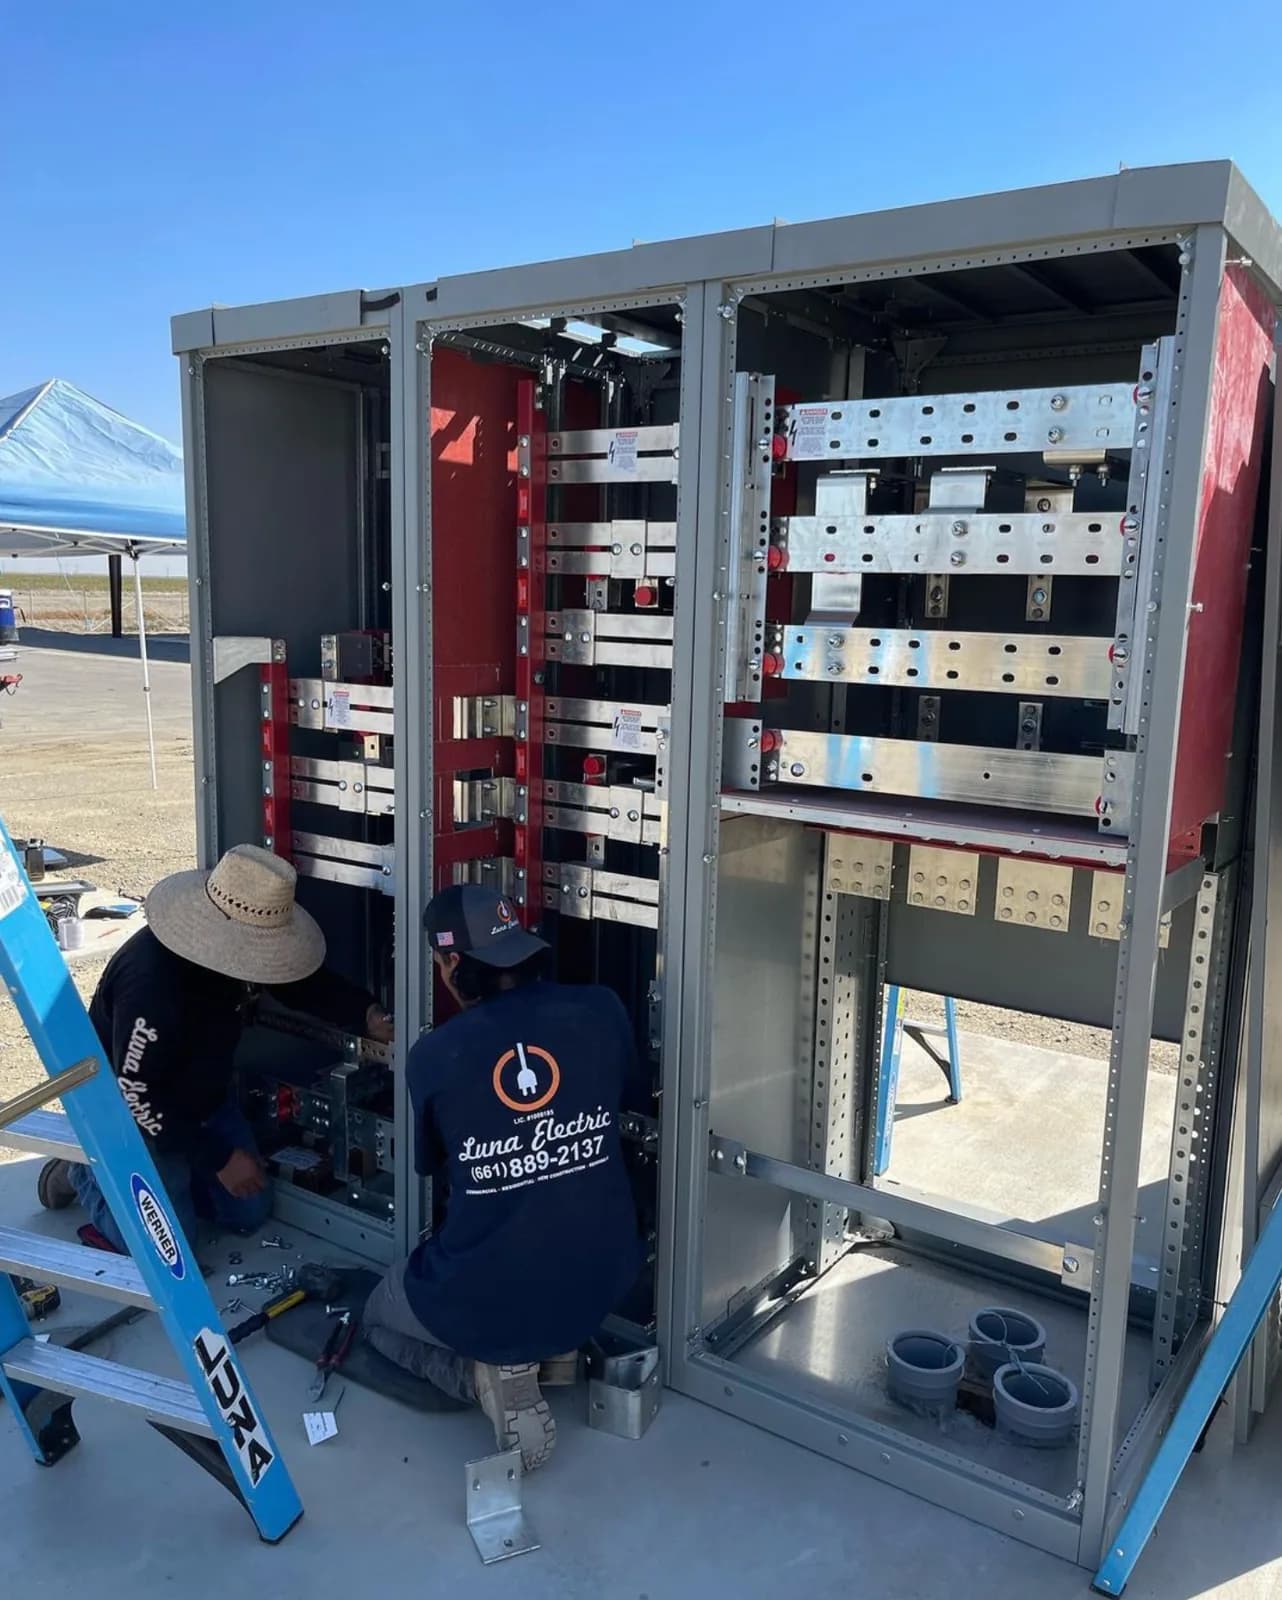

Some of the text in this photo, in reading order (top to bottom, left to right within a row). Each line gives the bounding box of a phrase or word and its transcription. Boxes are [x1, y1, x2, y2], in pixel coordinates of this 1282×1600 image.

[122, 1017, 158, 1074] Luna
[458, 1105, 611, 1161] Luna Electric
[142, 1195, 177, 1260] WERNER
[194, 1336, 273, 1486] LUNA
